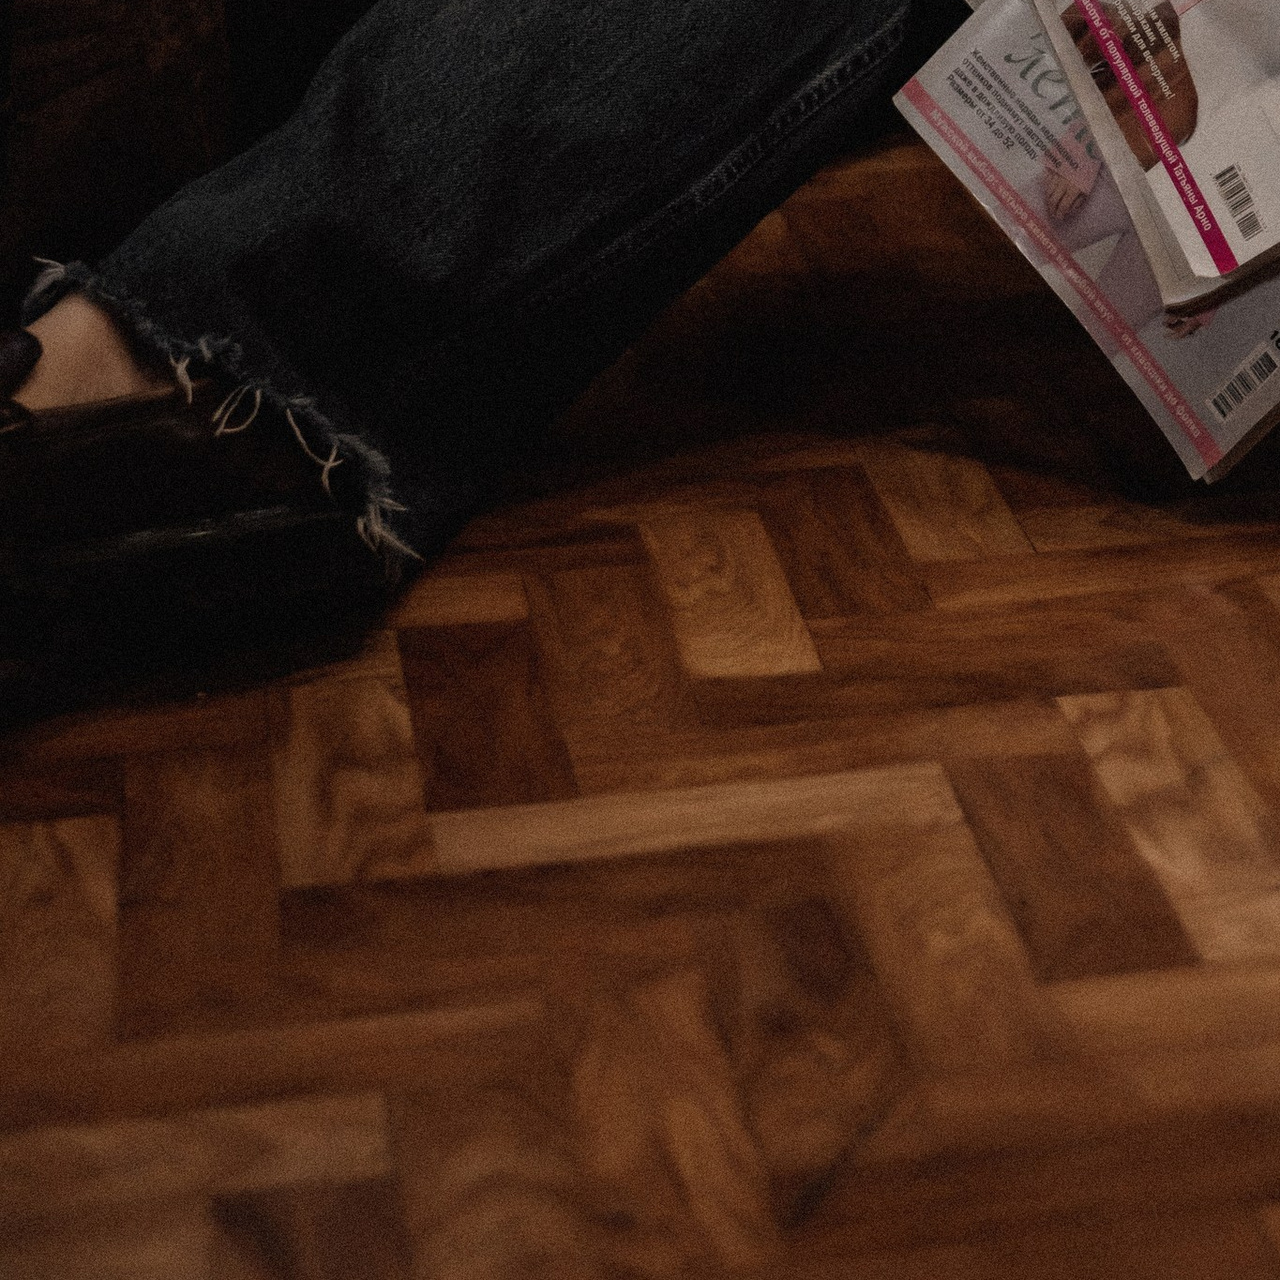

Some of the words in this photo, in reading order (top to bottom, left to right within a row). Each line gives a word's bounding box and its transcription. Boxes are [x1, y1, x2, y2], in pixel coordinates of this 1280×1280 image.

[1131, 31, 1147, 51] для
[1141, 48, 1175, 100] вечеринок!
[1153, 18, 1182, 63] жилетом,
[944, 73, 978, 110] Размеры
[974, 107, 987, 119] от
[981, 115, 997, 129] 34
[990, 126, 1006, 140] до
[1000, 136, 1015, 150] 52
[960, 56, 994, 91] оттенков
[989, 88, 1025, 127] поднимут
[1021, 124, 1063, 169] настроение
[969, 48, 1018, 100] Женственные
[1012, 96, 1043, 127] наряды
[1097, 26, 1110, 40] от
[1104, 39, 1143, 98] популярной
[1135, 97, 1178, 164] телеведущей
[1171, 162, 1199, 205] Татьяны
[1192, 202, 1214, 232] Арно
